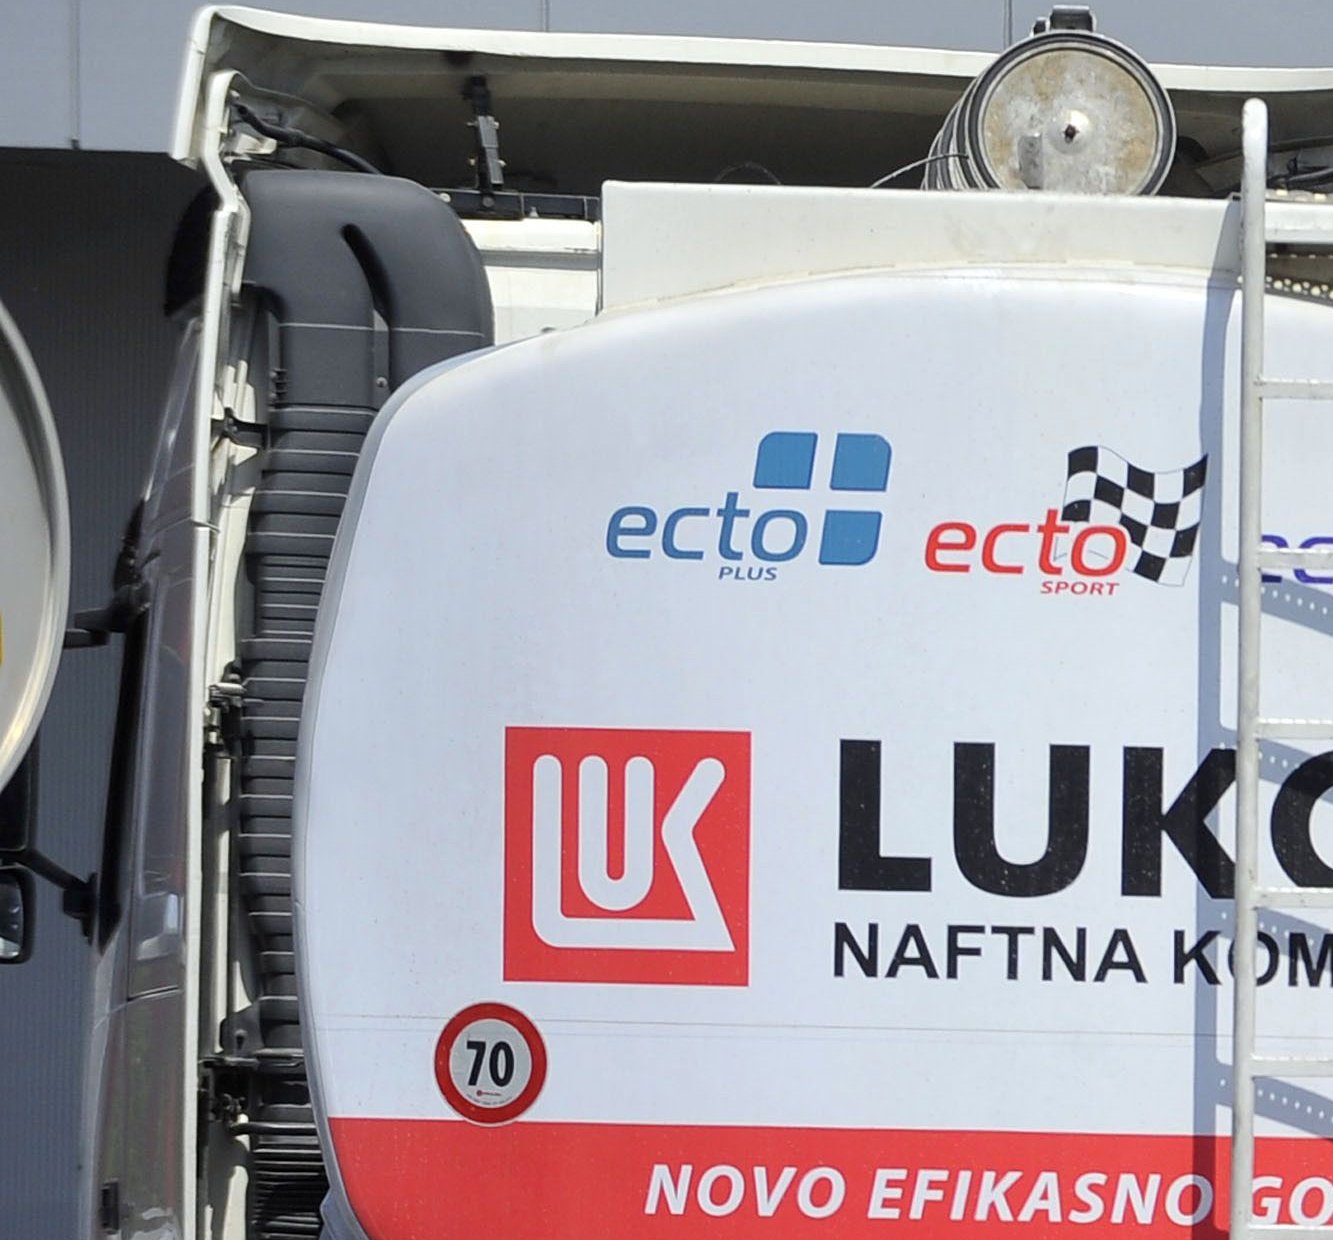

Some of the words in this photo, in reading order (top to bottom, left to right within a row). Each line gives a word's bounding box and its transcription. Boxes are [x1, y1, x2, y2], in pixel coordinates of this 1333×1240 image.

[605, 492, 808, 561] ecto
[924, 509, 1128, 577] ecto
[718, 566, 777, 581] PLUS
[1040, 581, 1120, 595] SPORT
[834, 921, 1146, 985] NAFTNA
[466, 1040, 515, 1087] 70
[644, 1164, 846, 1219] NOVO
[866, 1168, 1214, 1227] EFIKASNO
